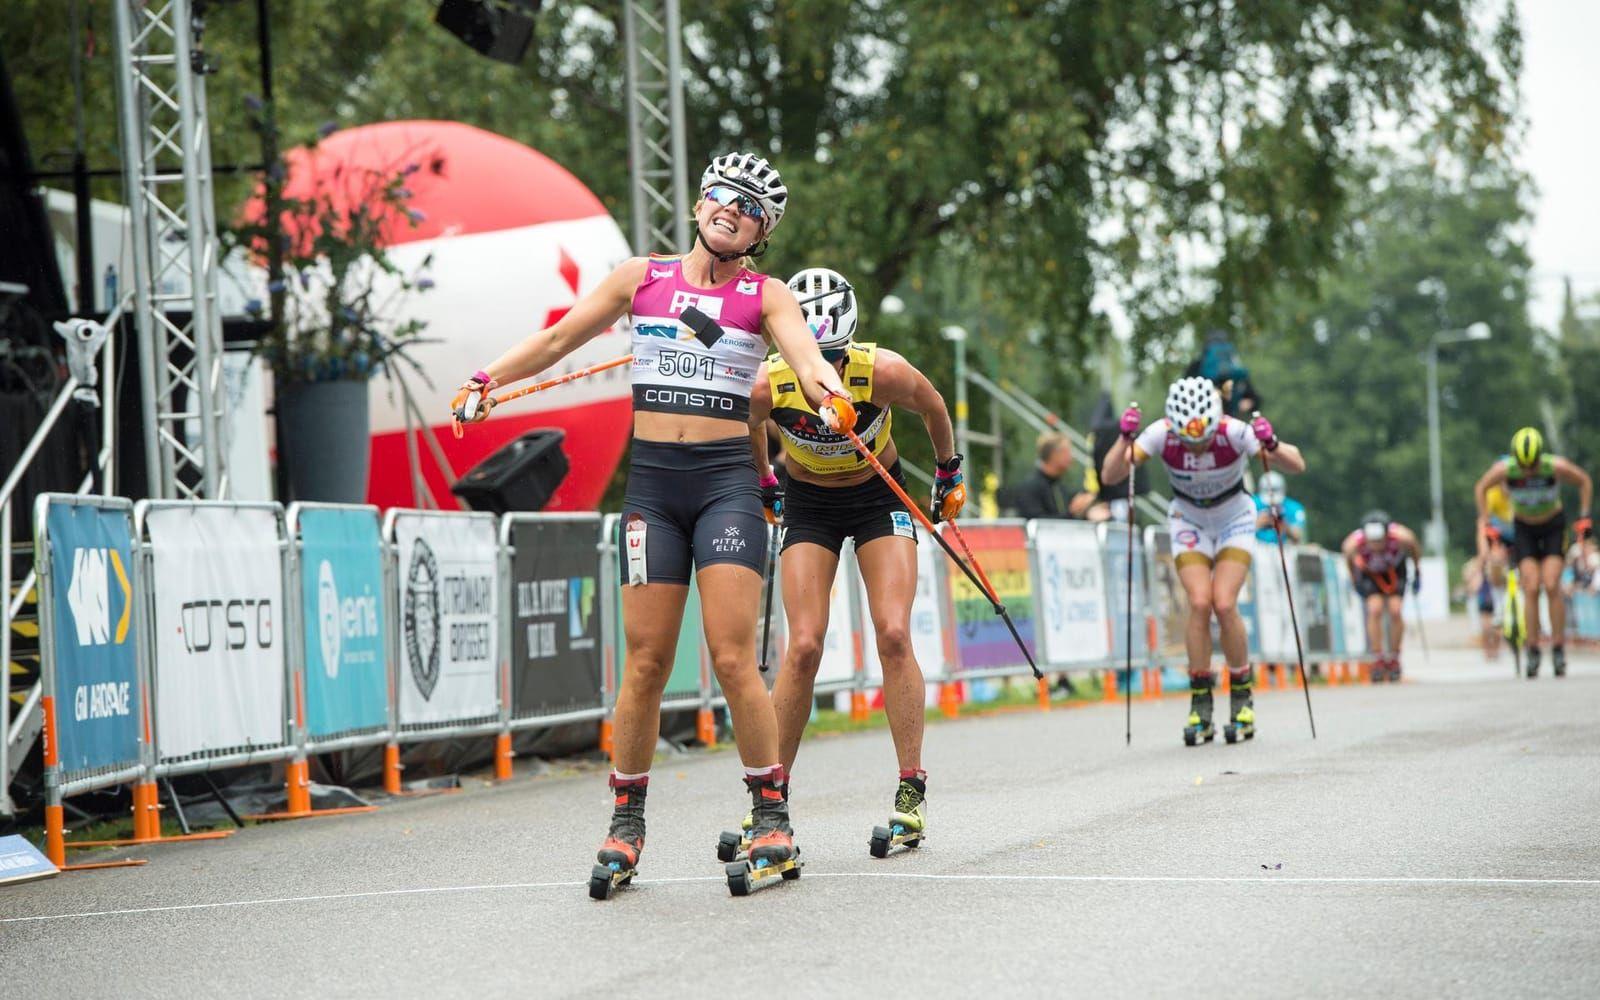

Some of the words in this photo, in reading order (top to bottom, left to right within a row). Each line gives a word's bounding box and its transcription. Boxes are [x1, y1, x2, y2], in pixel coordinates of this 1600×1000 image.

[658, 351, 716, 381] 501
[645, 389, 734, 411] CONSTO
[716, 545, 742, 553] ELIT
